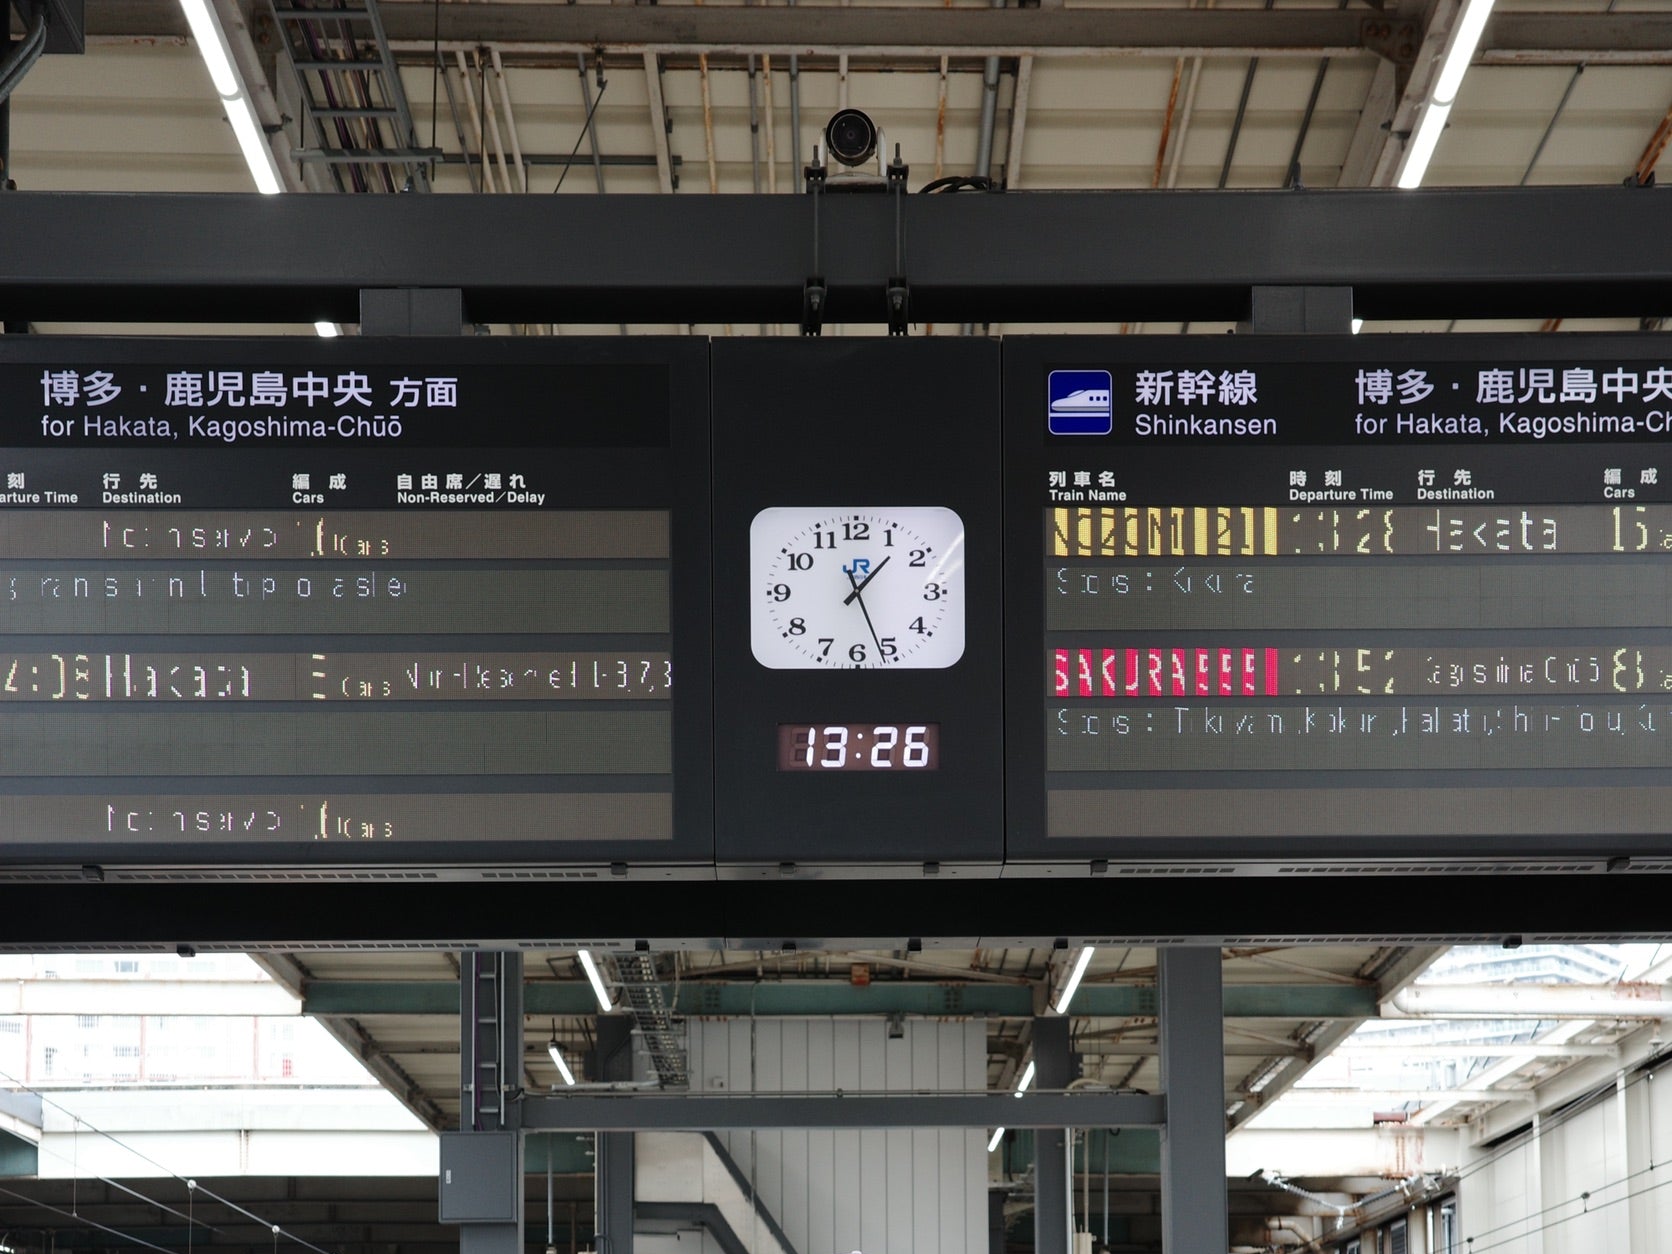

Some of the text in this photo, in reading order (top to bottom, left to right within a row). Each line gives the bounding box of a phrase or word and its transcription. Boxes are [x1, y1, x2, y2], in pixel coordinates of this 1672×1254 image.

[1136, 370, 1257, 405] 新幹線
[41, 415, 401, 442] for Hakata, Kagoshima-Chūō
[1136, 414, 1276, 435] Shinkansen
[1356, 414, 1387, 434] for
[1398, 414, 1488, 436] Hakata,
[44, 492, 78, 503] Time
[103, 492, 181, 503] Destination
[293, 492, 324, 503] Cars
[1049, 489, 1127, 501] Train Name
[1290, 489, 1393, 503] Departure Time
[1418, 488, 1494, 500] Destination
[1604, 487, 1635, 498] Cars
[843, 523, 869, 540] 12
[885, 530, 893, 546] 1
[814, 532, 836, 548] 11
[788, 553, 813, 570] 10
[910, 550, 925, 566] 2
[842, 559, 870, 574] JR
[774, 584, 790, 601] 9
[924, 584, 940, 600] 3
[789, 618, 806, 635] 8
[909, 617, 926, 633] 4
[819, 639, 834, 656] 7
[849, 644, 865, 662] 6
[880, 638, 896, 656] 5
[807, 727, 928, 767] 13:26
